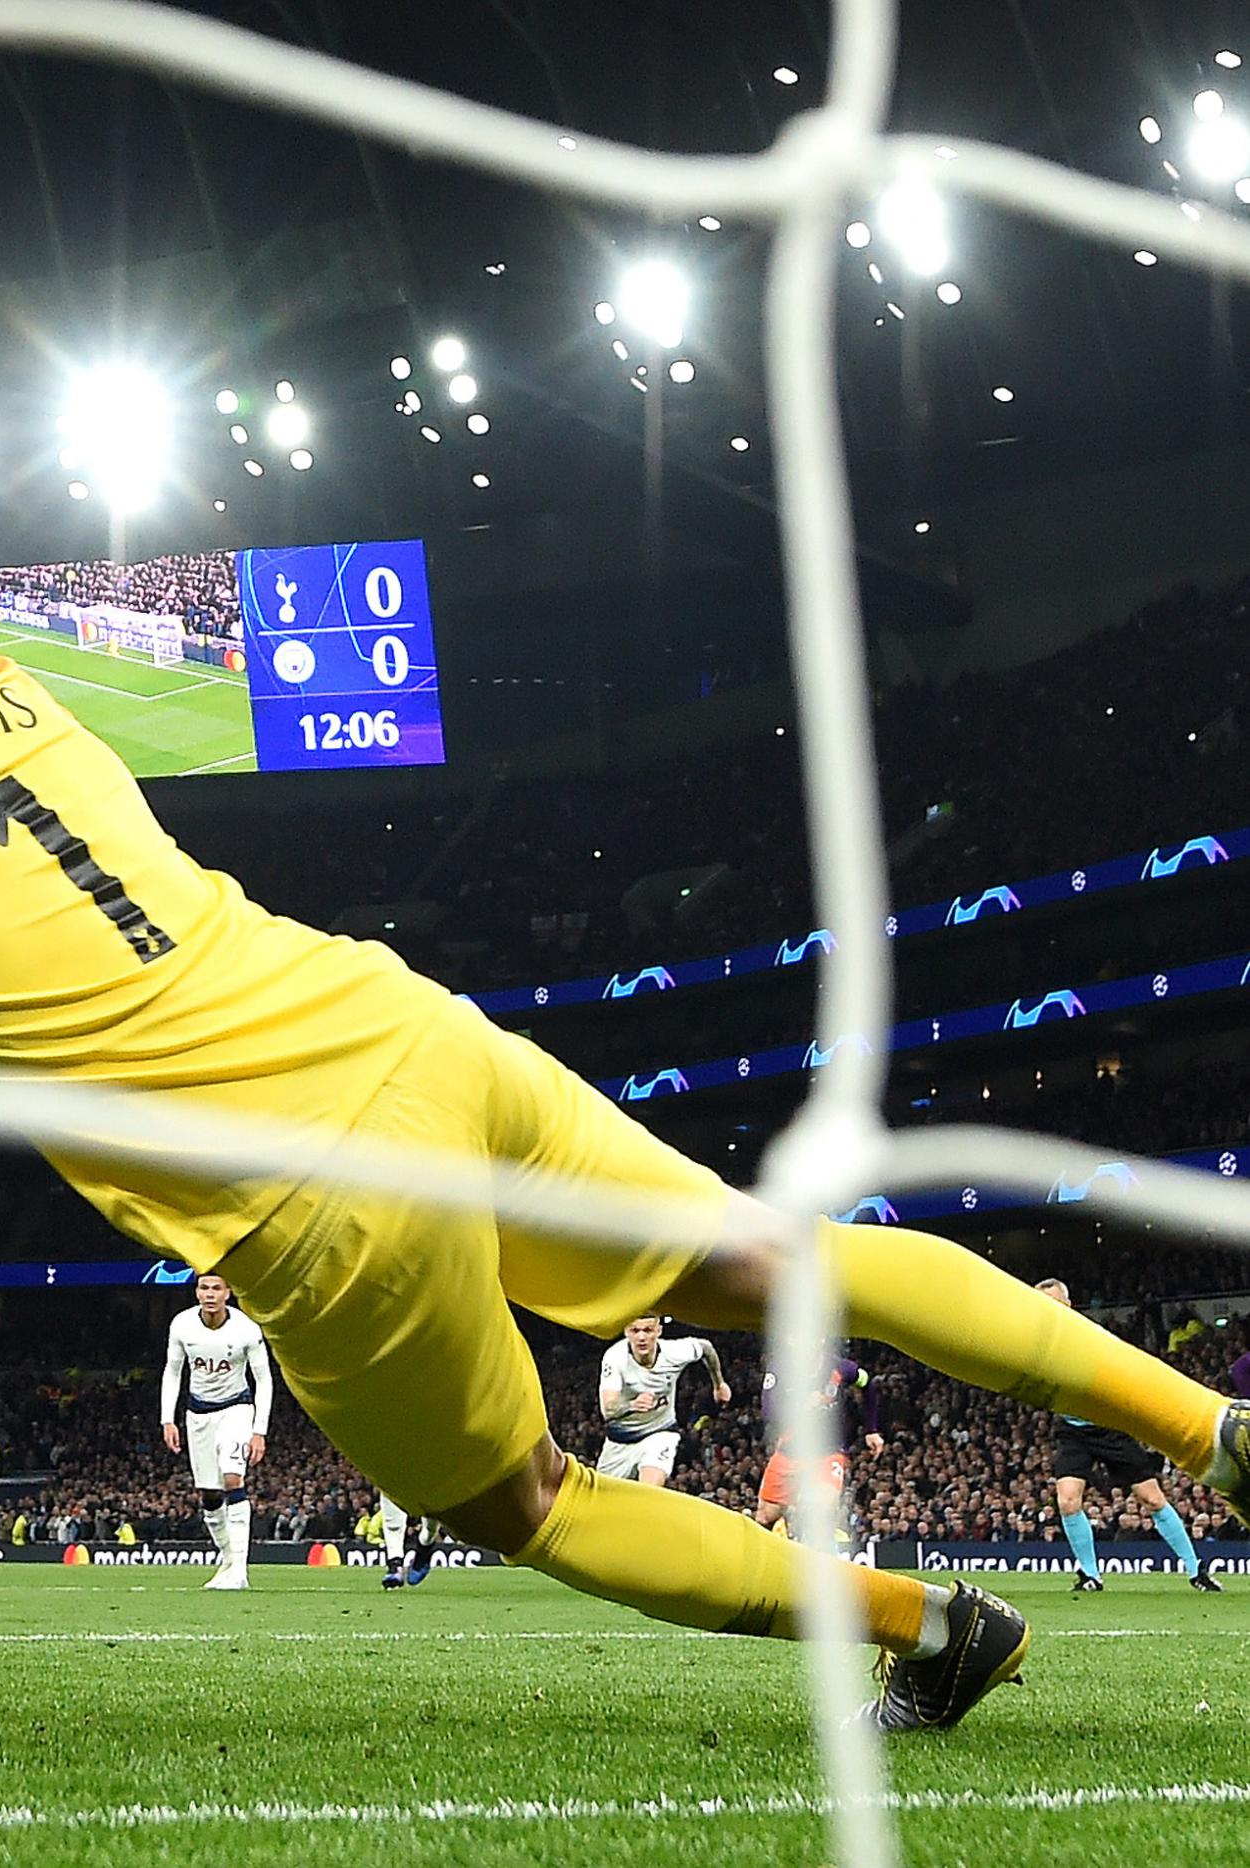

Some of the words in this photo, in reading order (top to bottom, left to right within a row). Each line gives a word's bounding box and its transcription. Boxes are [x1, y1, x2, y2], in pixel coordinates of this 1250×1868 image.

[365, 567, 403, 618] 0
[372, 635, 409, 686] 0
[299, 710, 400, 750] 12:06
[193, 1357, 232, 1373] AIA
[347, 1548, 482, 1568] priess
[1016, 1557, 1154, 1573] CHAMIONS
